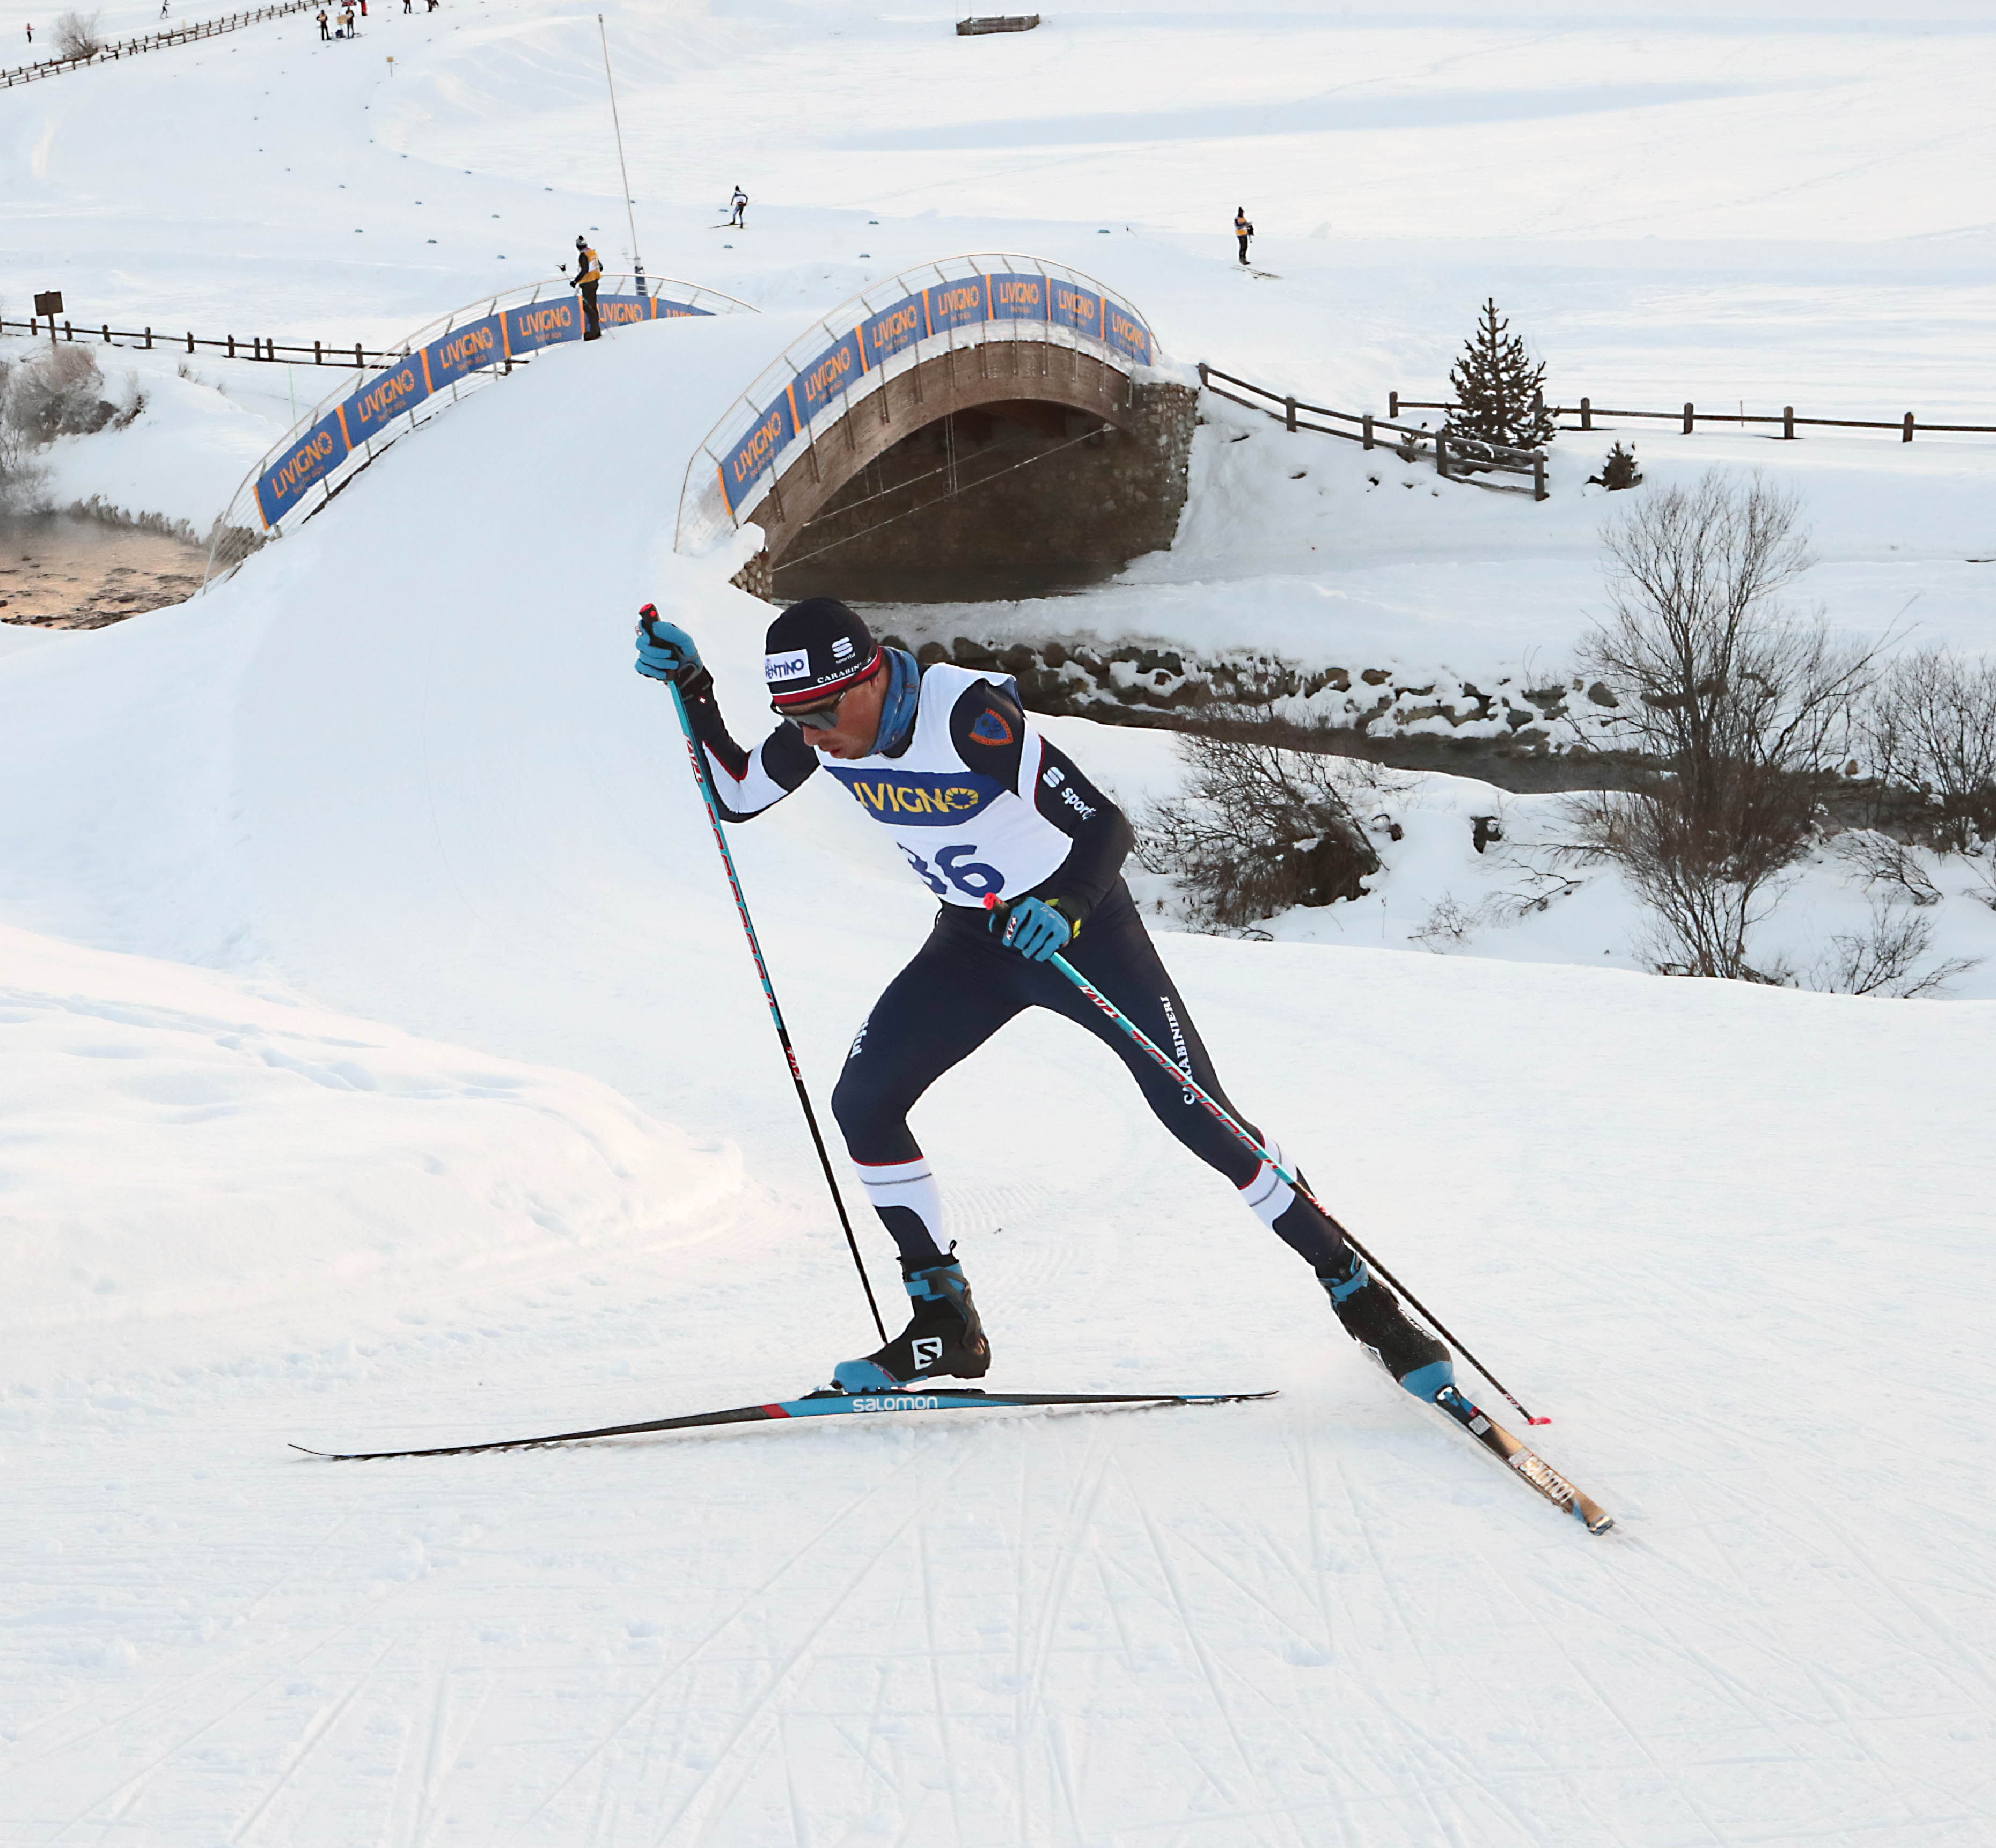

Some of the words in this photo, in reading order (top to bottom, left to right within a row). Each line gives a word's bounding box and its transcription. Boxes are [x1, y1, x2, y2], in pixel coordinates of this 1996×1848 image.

[938, 285, 979, 316] LIVIGNO
[1000, 282, 1039, 305] LIVIGNO
[519, 305, 571, 336] LIVIGNO
[872, 305, 917, 348] LIVIGNO
[439, 327, 493, 369] LIVIGNO
[804, 347, 850, 402] LIVIGNO
[357, 369, 415, 423] LIVIGNO
[272, 432, 333, 498] LIVIGNO
[734, 412, 781, 482] LIVIGNO
[853, 782, 979, 813] IVIGNO
[853, 1396, 938, 1412] salomon
[1513, 1456, 1575, 1503] salomon
